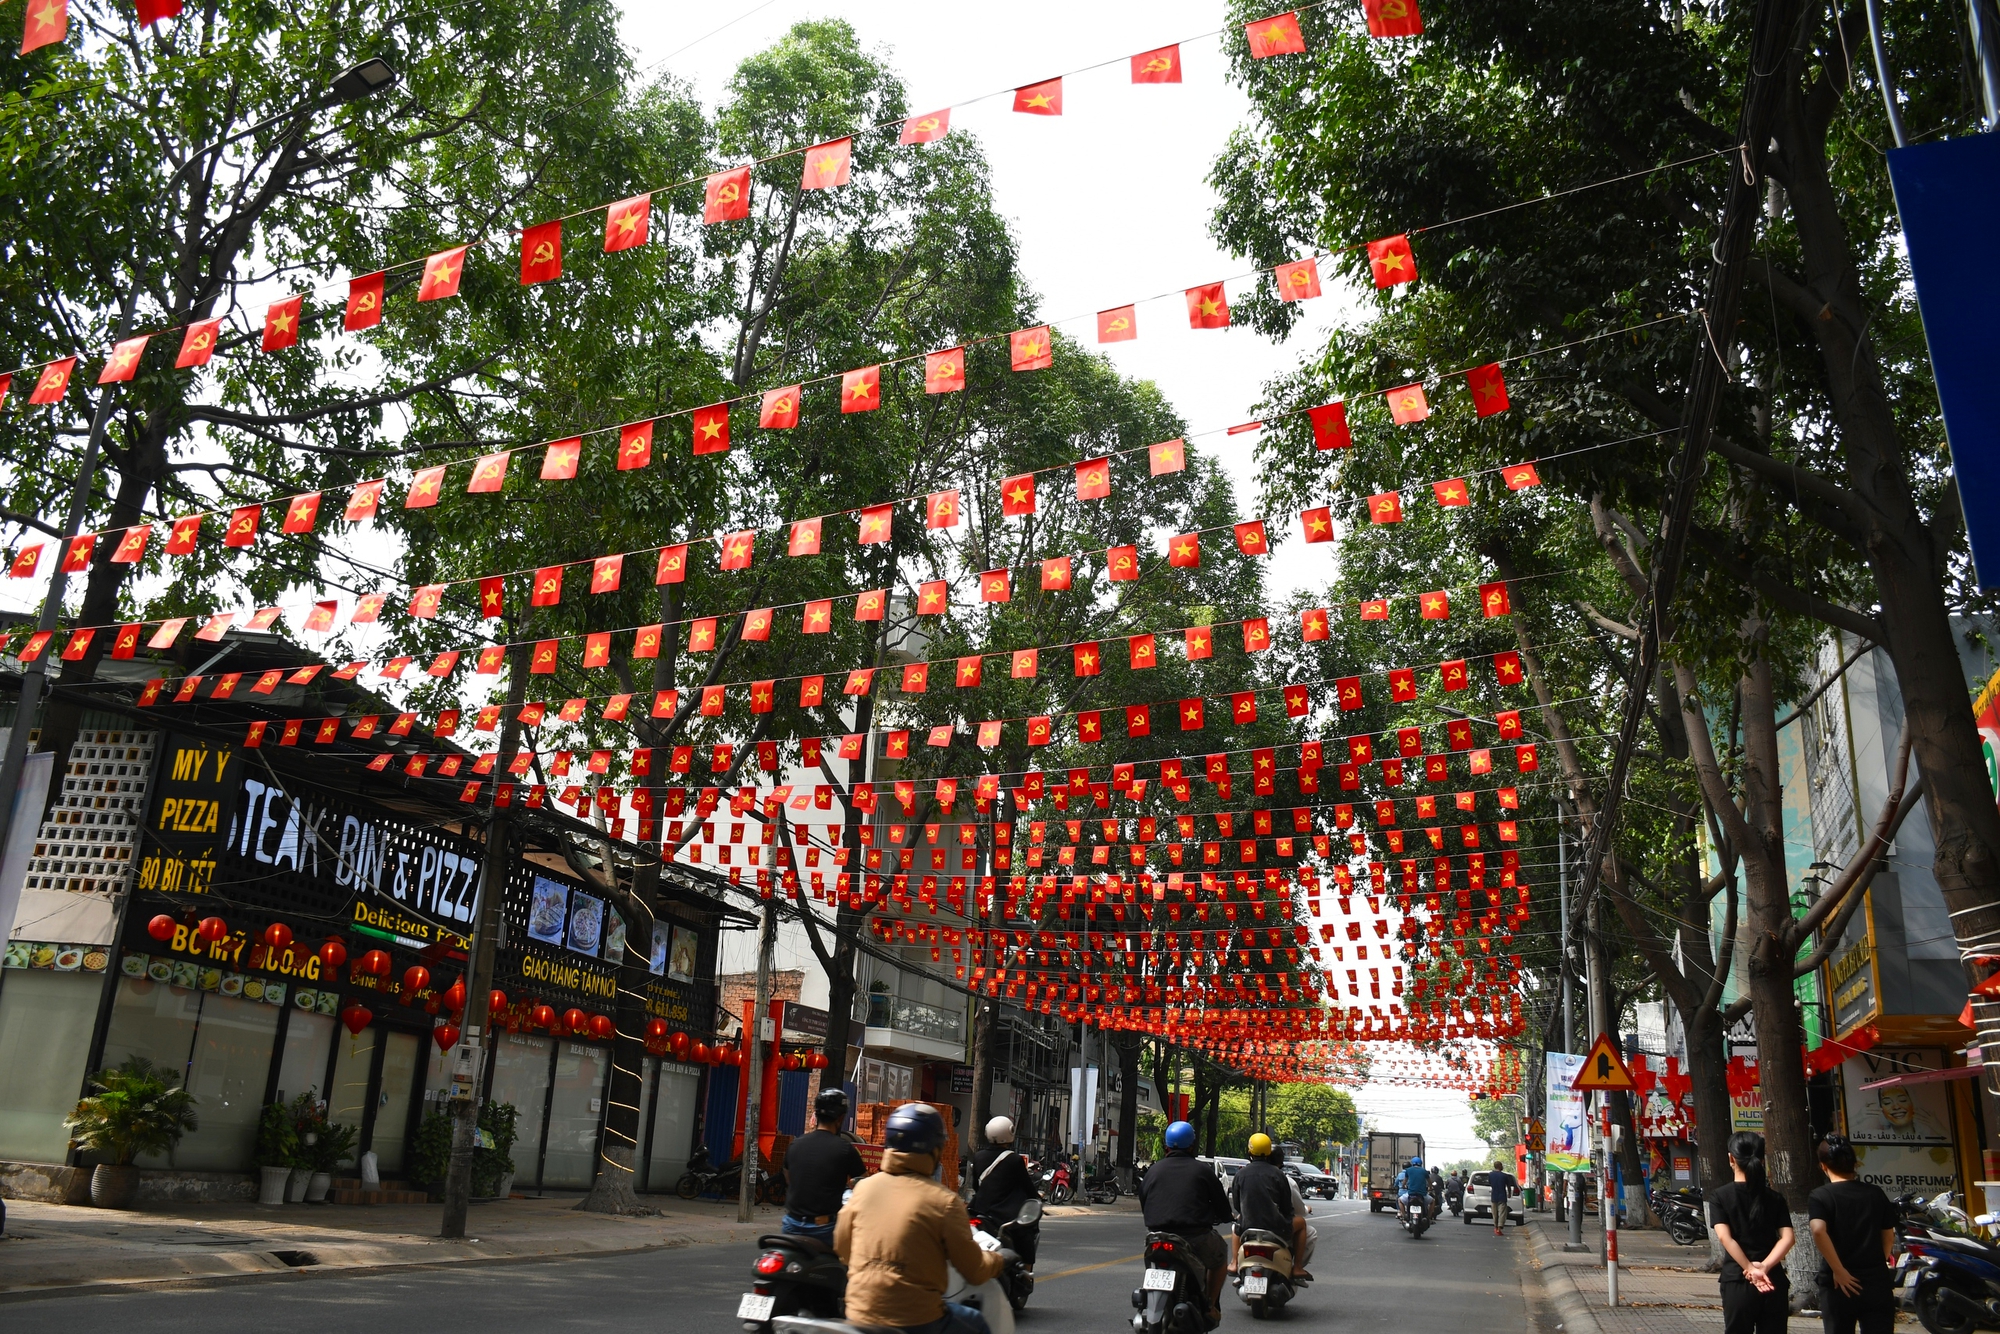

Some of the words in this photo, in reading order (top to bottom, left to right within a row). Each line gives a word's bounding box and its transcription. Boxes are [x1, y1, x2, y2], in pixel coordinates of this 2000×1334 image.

[159, 797, 219, 833] PIZZA
[139, 848, 161, 890] BÒ
[187, 847, 217, 894] TẾT
[335, 815, 388, 896] BIN
[393, 852, 409, 900] &
[354, 901, 429, 938] Delicious
[522, 955, 549, 982] GIAO
[550, 961, 579, 989] HÀNG
[582, 969, 600, 997] TẬN
[600, 977, 616, 999] NƠI
[570, 1043, 584, 1055] REAL
[585, 1047, 600, 1058] FOOD
[1862, 1051, 1923, 1074] VIC
[1896, 1175, 1951, 1187] PERFUME
